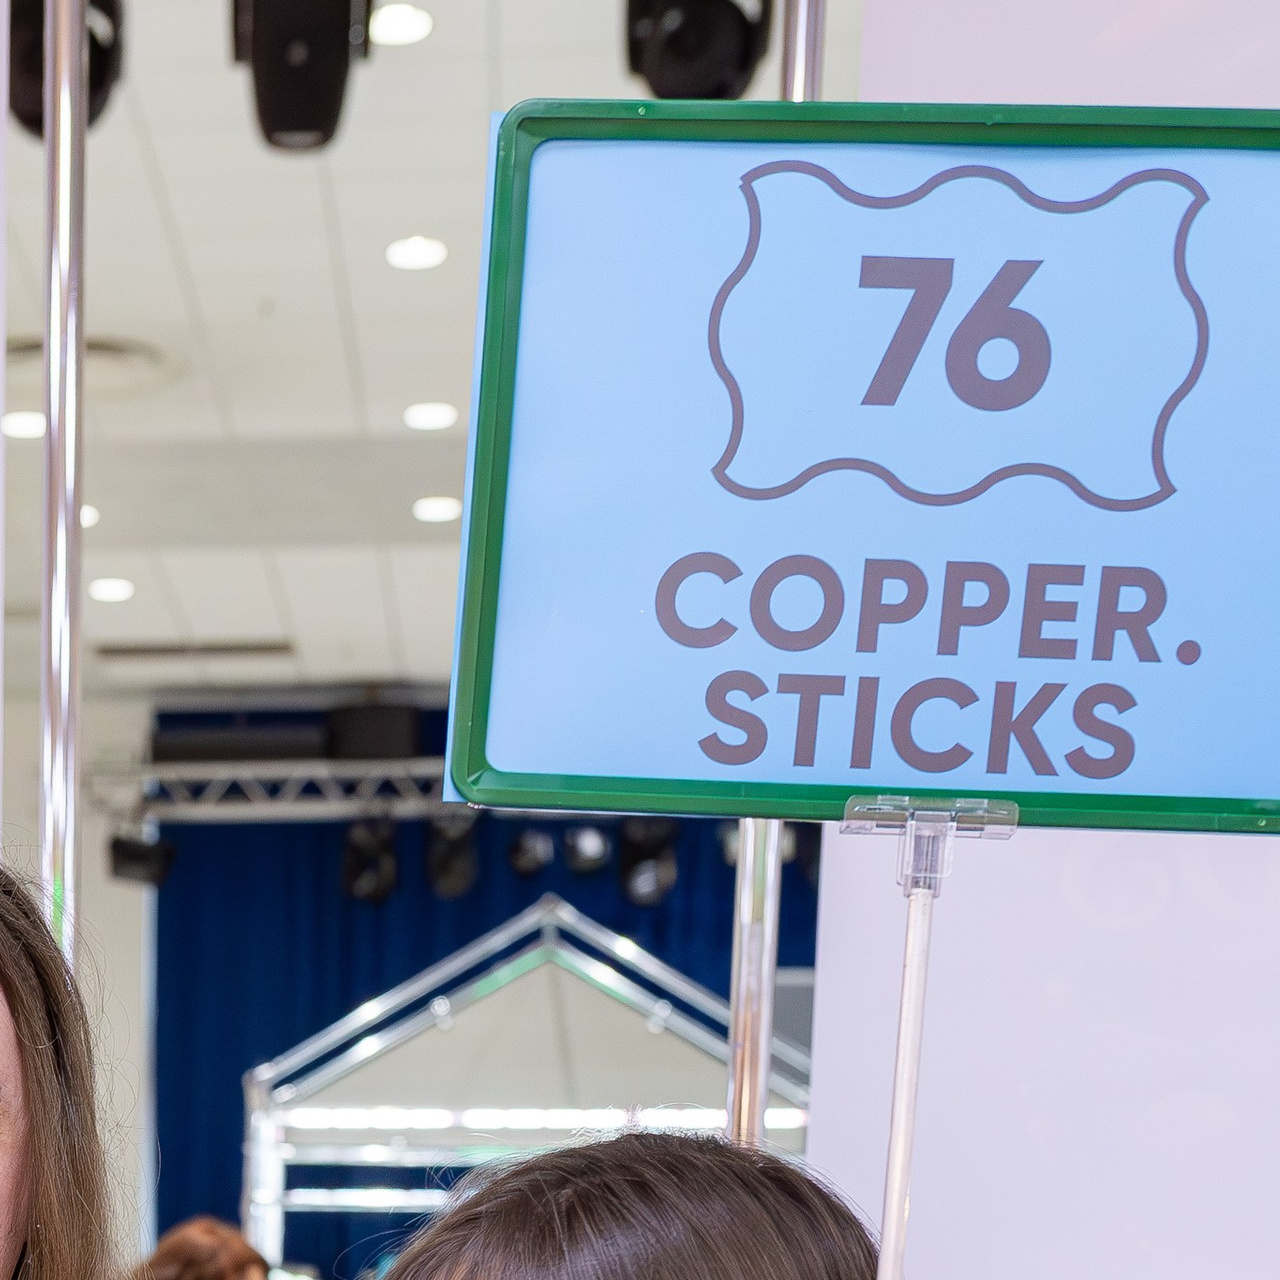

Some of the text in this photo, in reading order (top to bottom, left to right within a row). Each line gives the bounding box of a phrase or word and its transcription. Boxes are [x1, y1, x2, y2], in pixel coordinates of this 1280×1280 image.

[858, 256, 1052, 412] 76
[655, 551, 1202, 666] COPPER.
[698, 670, 1139, 780] STICKS
